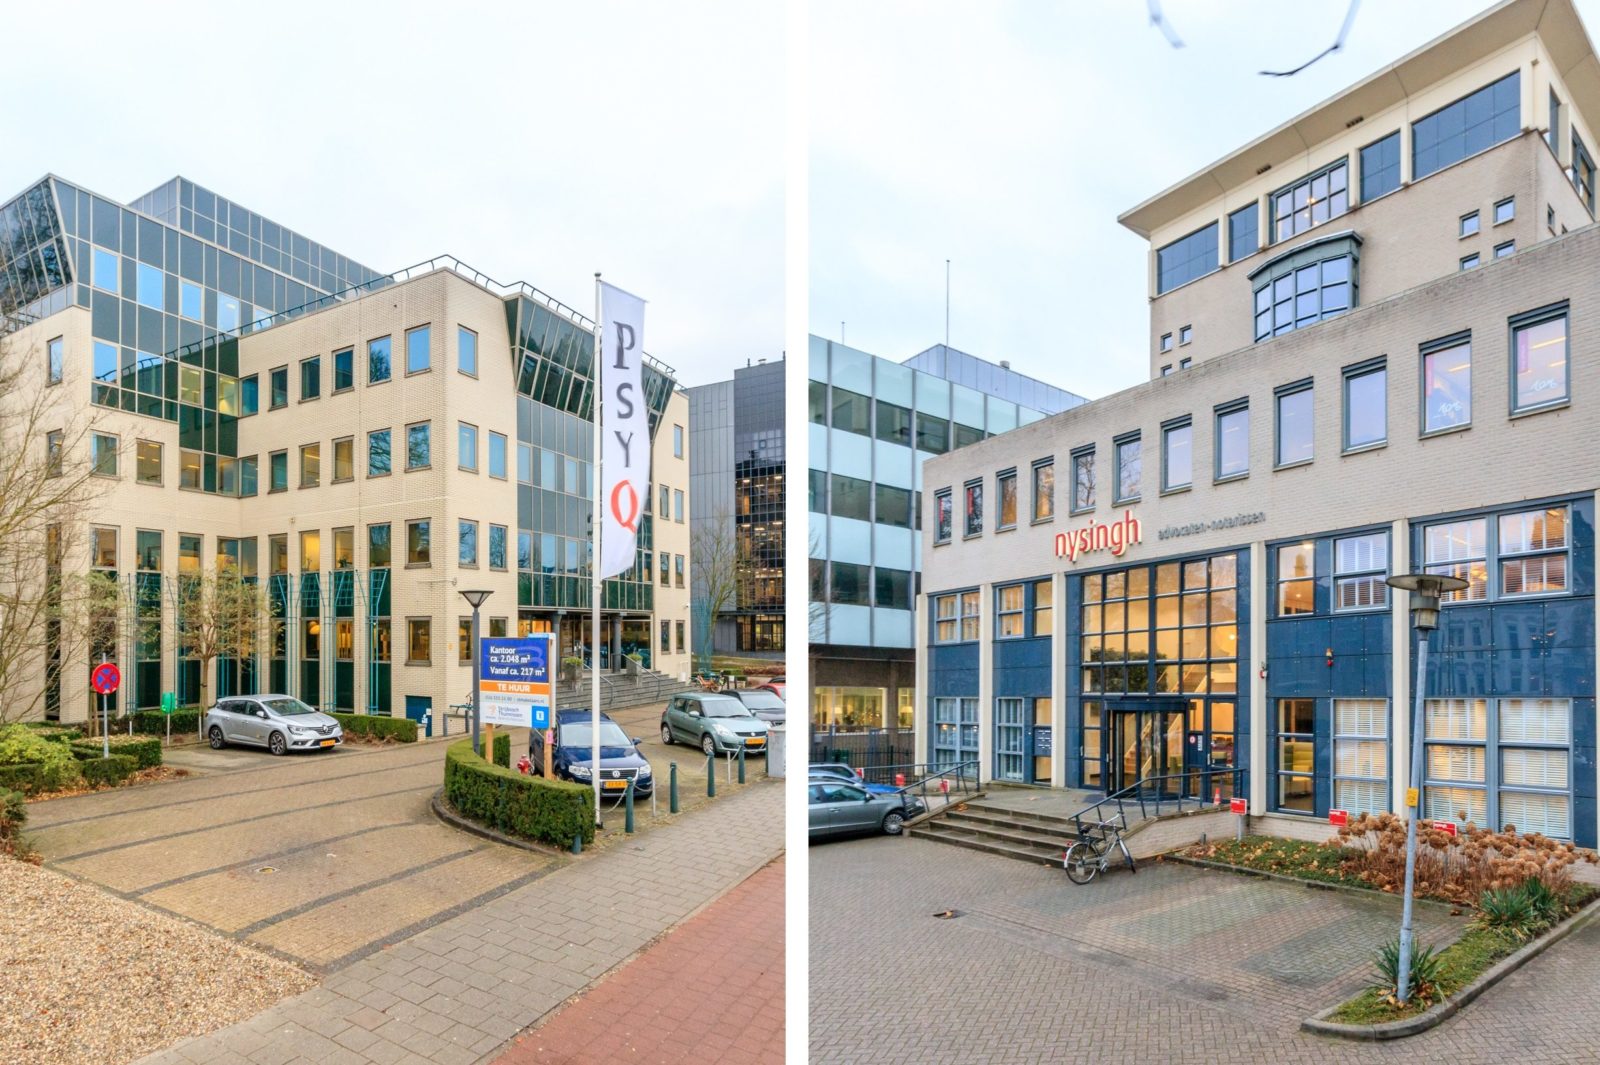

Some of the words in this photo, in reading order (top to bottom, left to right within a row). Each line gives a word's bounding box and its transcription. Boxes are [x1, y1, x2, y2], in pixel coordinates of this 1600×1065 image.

[610, 320, 638, 534] PSYQ
[1055, 510, 1142, 563] nysingh
[490, 646, 516, 654] Kantoor
[501, 655, 519, 663] 2.048
[490, 667, 509, 675] Vanaf
[510, 668, 519, 676] ca.
[520, 667, 533, 676] 217
[497, 683, 507, 691] TE
[508, 684, 530, 693] HUUR
